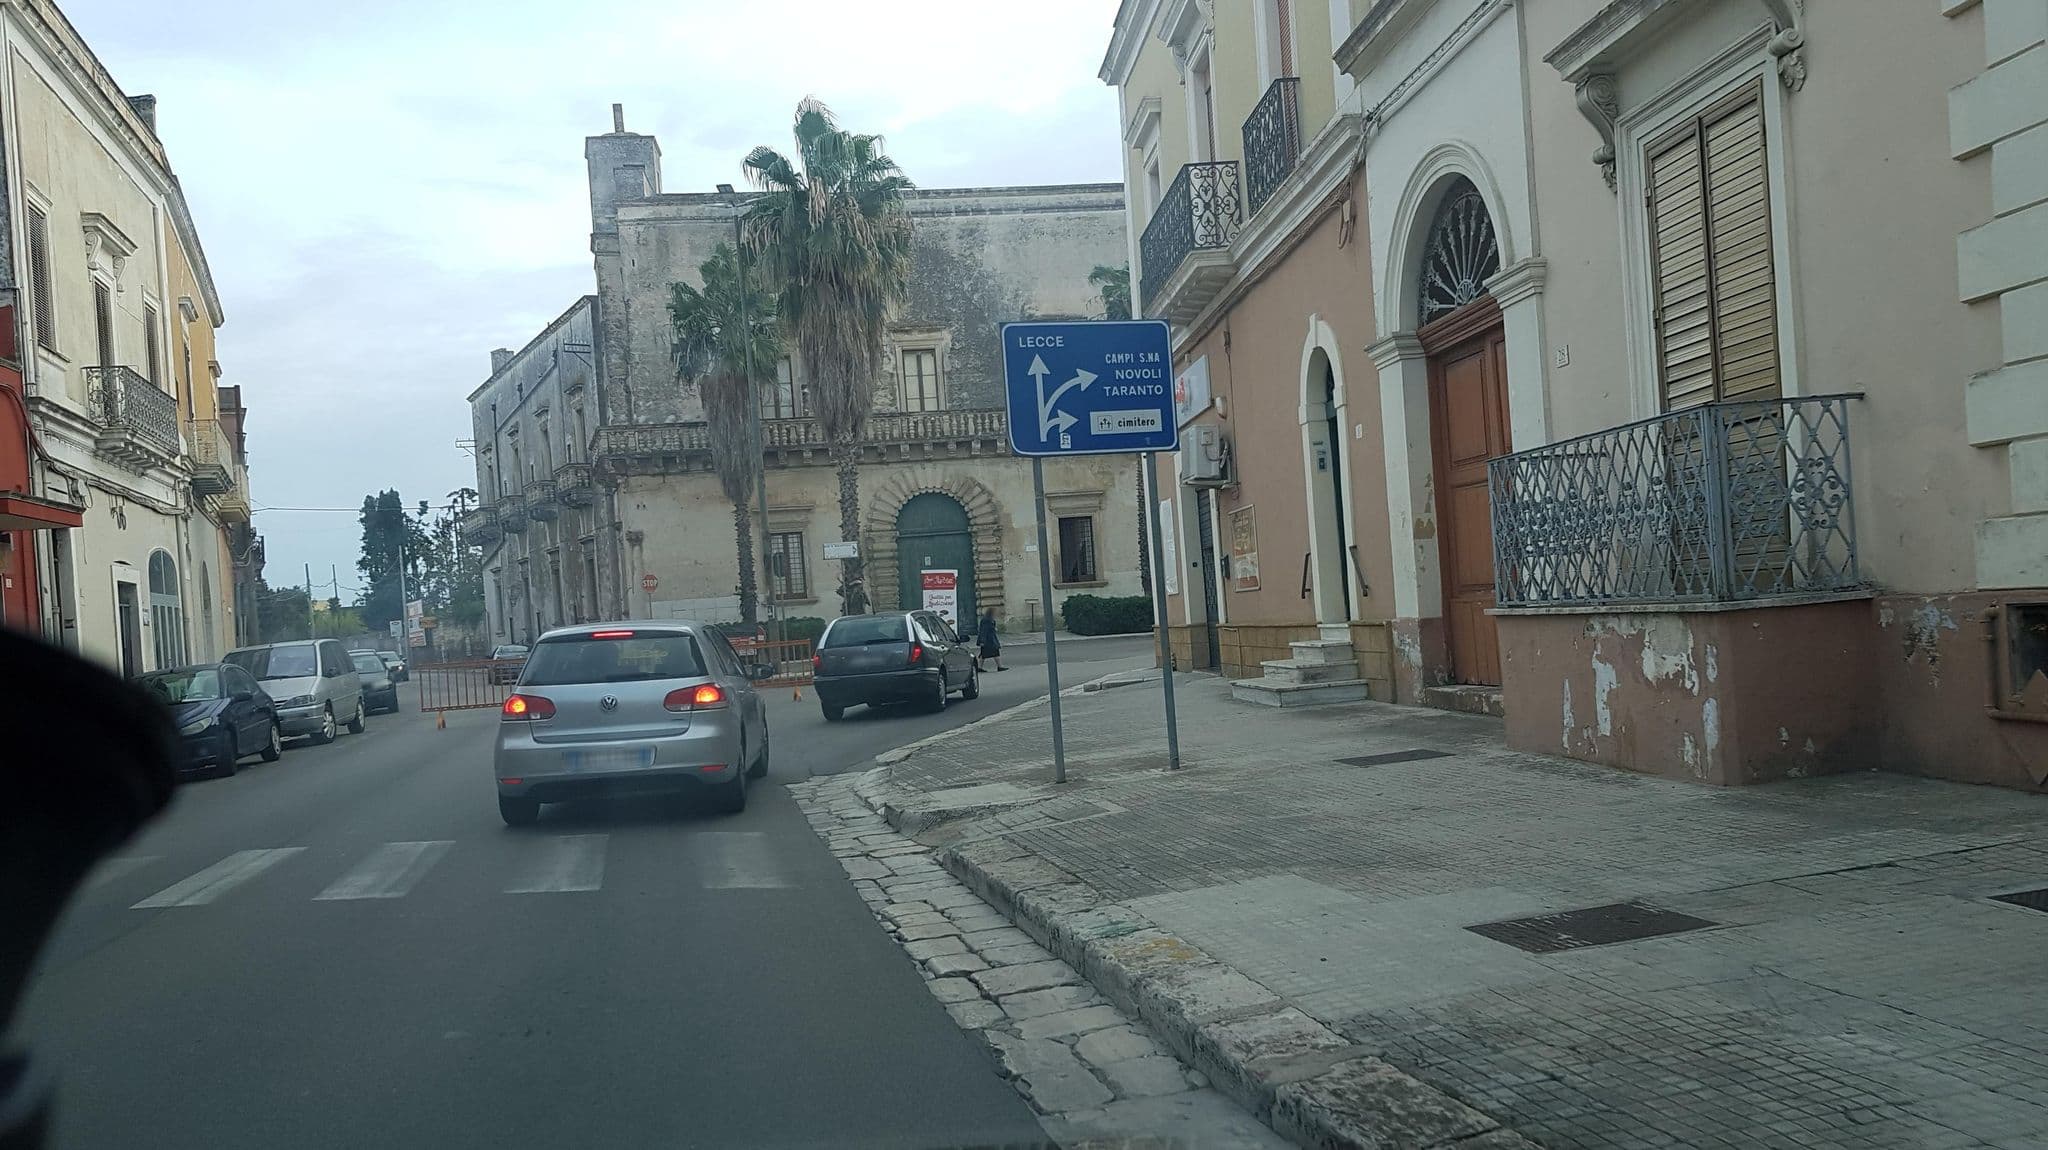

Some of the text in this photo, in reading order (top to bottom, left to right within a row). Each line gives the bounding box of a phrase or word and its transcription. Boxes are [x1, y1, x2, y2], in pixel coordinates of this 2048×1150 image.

[1019, 336, 1065, 347] LECCE
[1105, 352, 1160, 364] CAMPI S.NA
[1115, 369, 1162, 380] NOVOLI
[1103, 385, 1163, 396] TARANTO
[1117, 416, 1156, 427] cimitero
[642, 579, 658, 587] STOP
